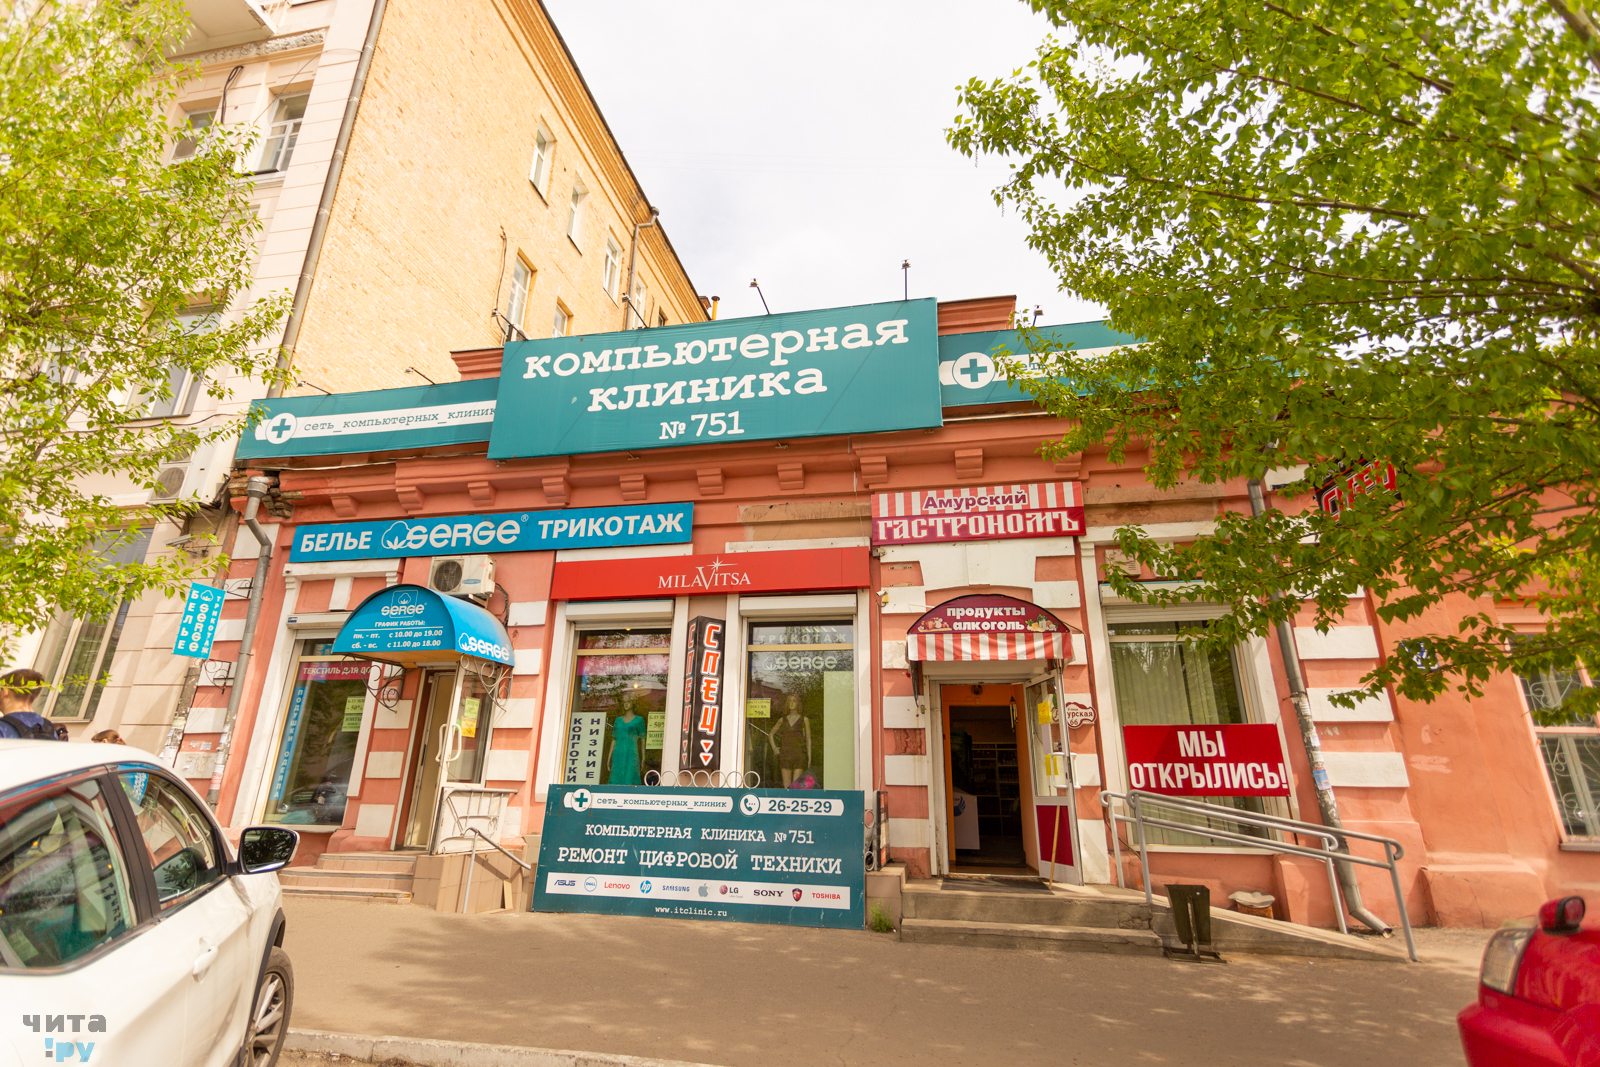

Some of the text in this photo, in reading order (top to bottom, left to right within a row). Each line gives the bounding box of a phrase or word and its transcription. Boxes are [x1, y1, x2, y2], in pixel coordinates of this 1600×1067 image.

[521, 318, 909, 380] компьютерная
[587, 367, 828, 412] клиника
[923, 490, 1028, 511] Амурский
[537, 512, 684, 540] ТРИКОТАЖ
[300, 530, 373, 553] БЕЛЬЕ
[177, 589, 200, 650] БЕЛЬЕ
[200, 596, 222, 654] ТРИКОТАЖ
[946, 606, 1026, 619] продукты
[952, 620, 1025, 631] алкоголь
[758, 633, 847, 644] ТРИКОТАЖ
[303, 667, 341, 675] ТЕКСТИЛЬ
[698, 623, 722, 737] СПЕЦ
[287, 689, 304, 742] ПОДУШКИ
[567, 718, 583, 782] КОЛГОТКИ
[586, 718, 600, 779] НИЗКИЕ
[1177, 730, 1226, 757] МЫ
[274, 751, 290, 798] ОДЕЯЛА
[1129, 763, 1289, 789] ОТКРЫЛИСЬ!
[768, 799, 832, 813] 26-25-29
[585, 824, 693, 839] КОМПЬЮТЕРНАЯ
[700, 828, 767, 842] КЛИНИКА
[557, 847, 842, 874] РЕМОНТ ЦИФРОВОЙ ТЕХНИКИ
[554, 879, 577, 887] ASUS
[604, 881, 631, 890] Lenovo
[753, 889, 784, 898] SONY
[812, 892, 841, 900] TOSHIBA
[655, 906, 728, 917] www.itclinic.ru
